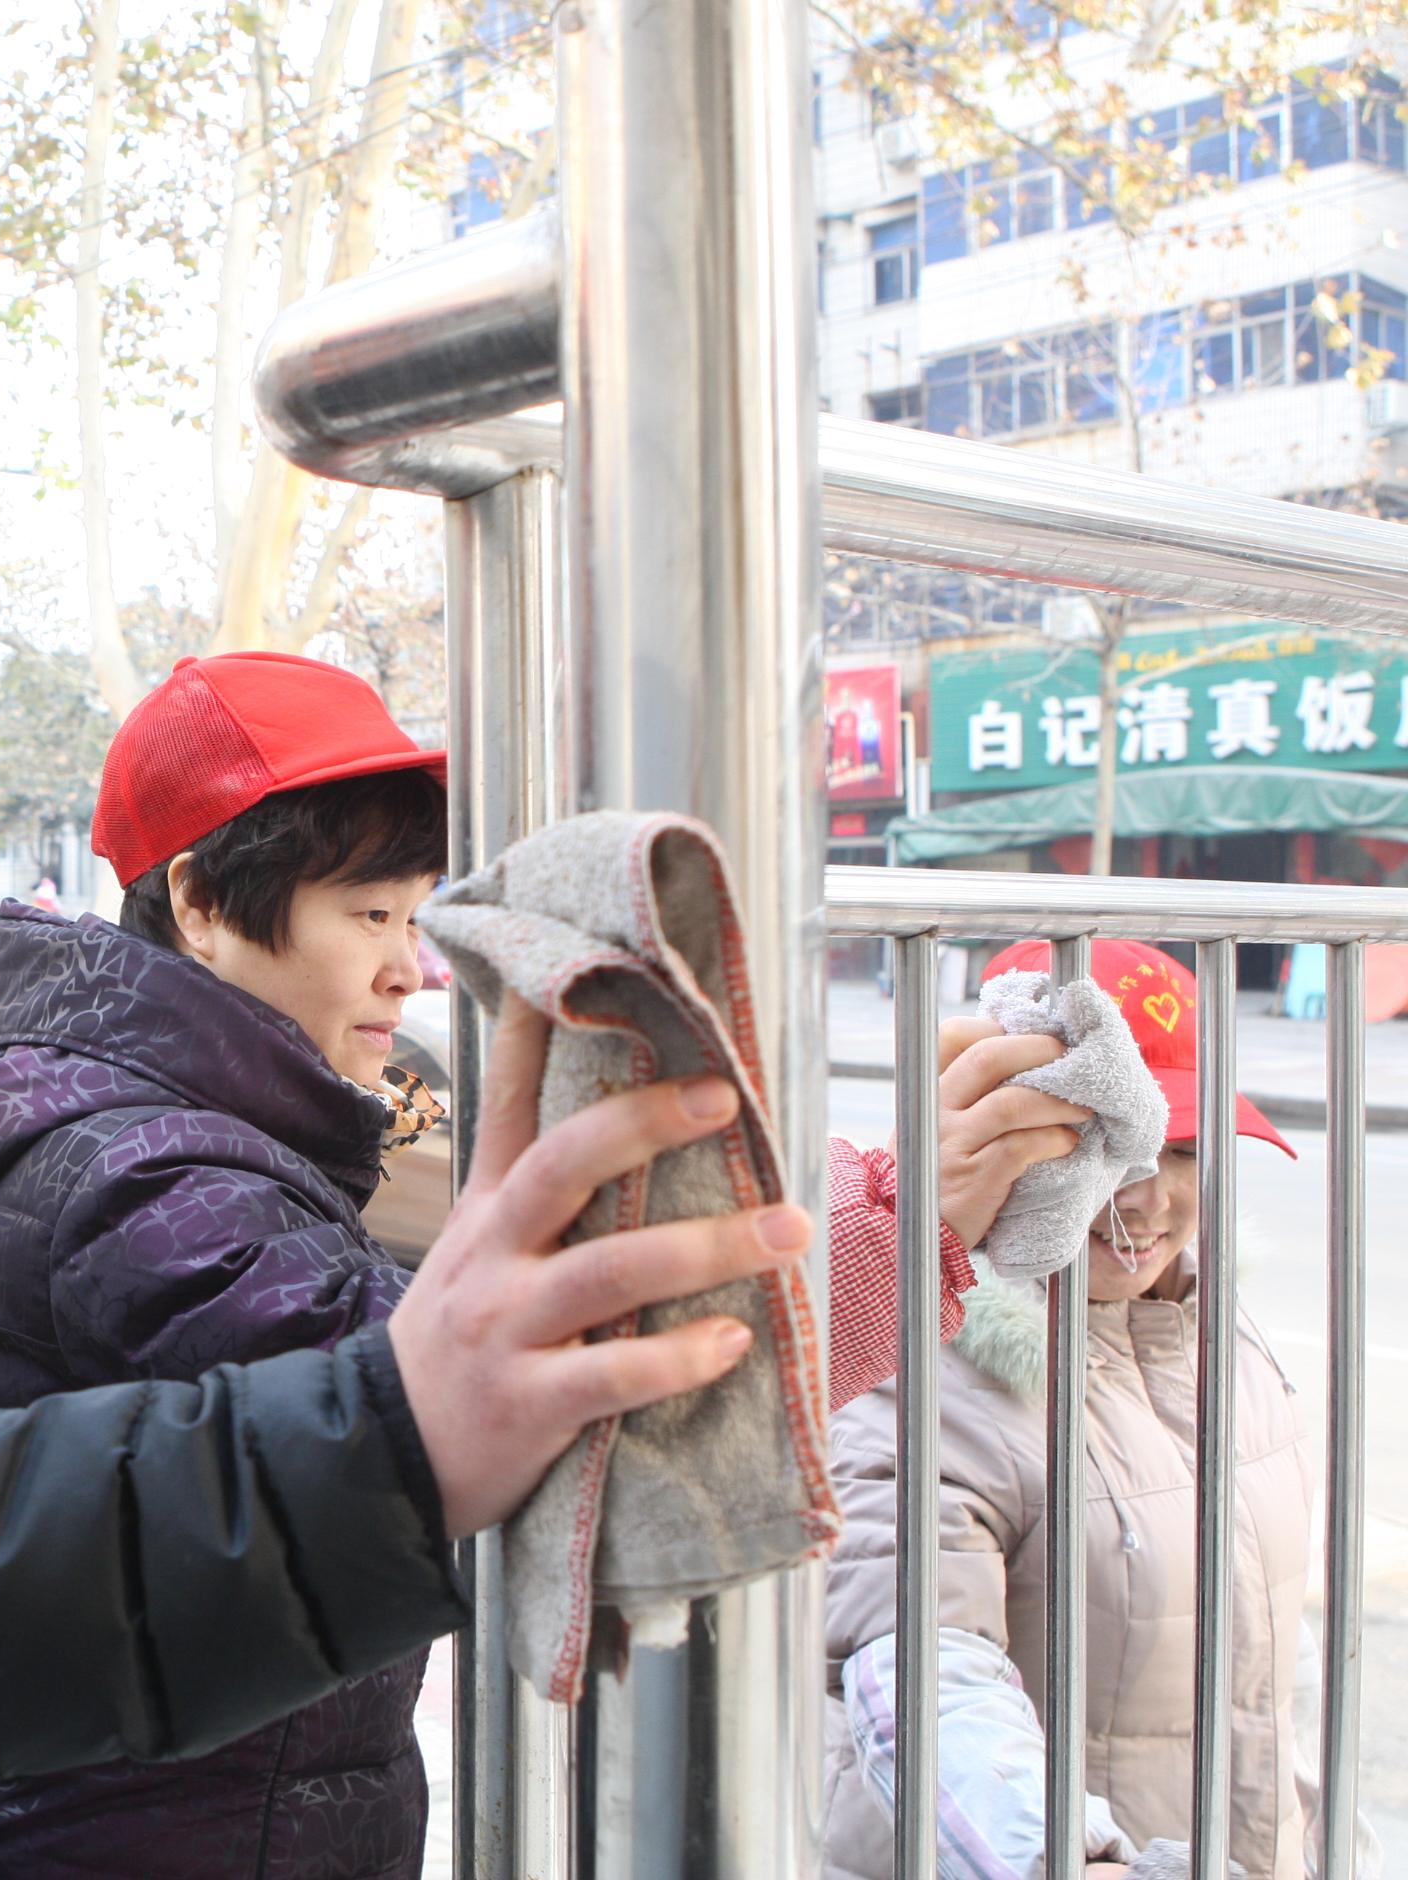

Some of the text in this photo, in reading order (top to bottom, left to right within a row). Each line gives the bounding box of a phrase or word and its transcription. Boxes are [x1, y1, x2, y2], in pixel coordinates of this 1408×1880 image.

[967, 670, 1408, 773] 白记清真饭
